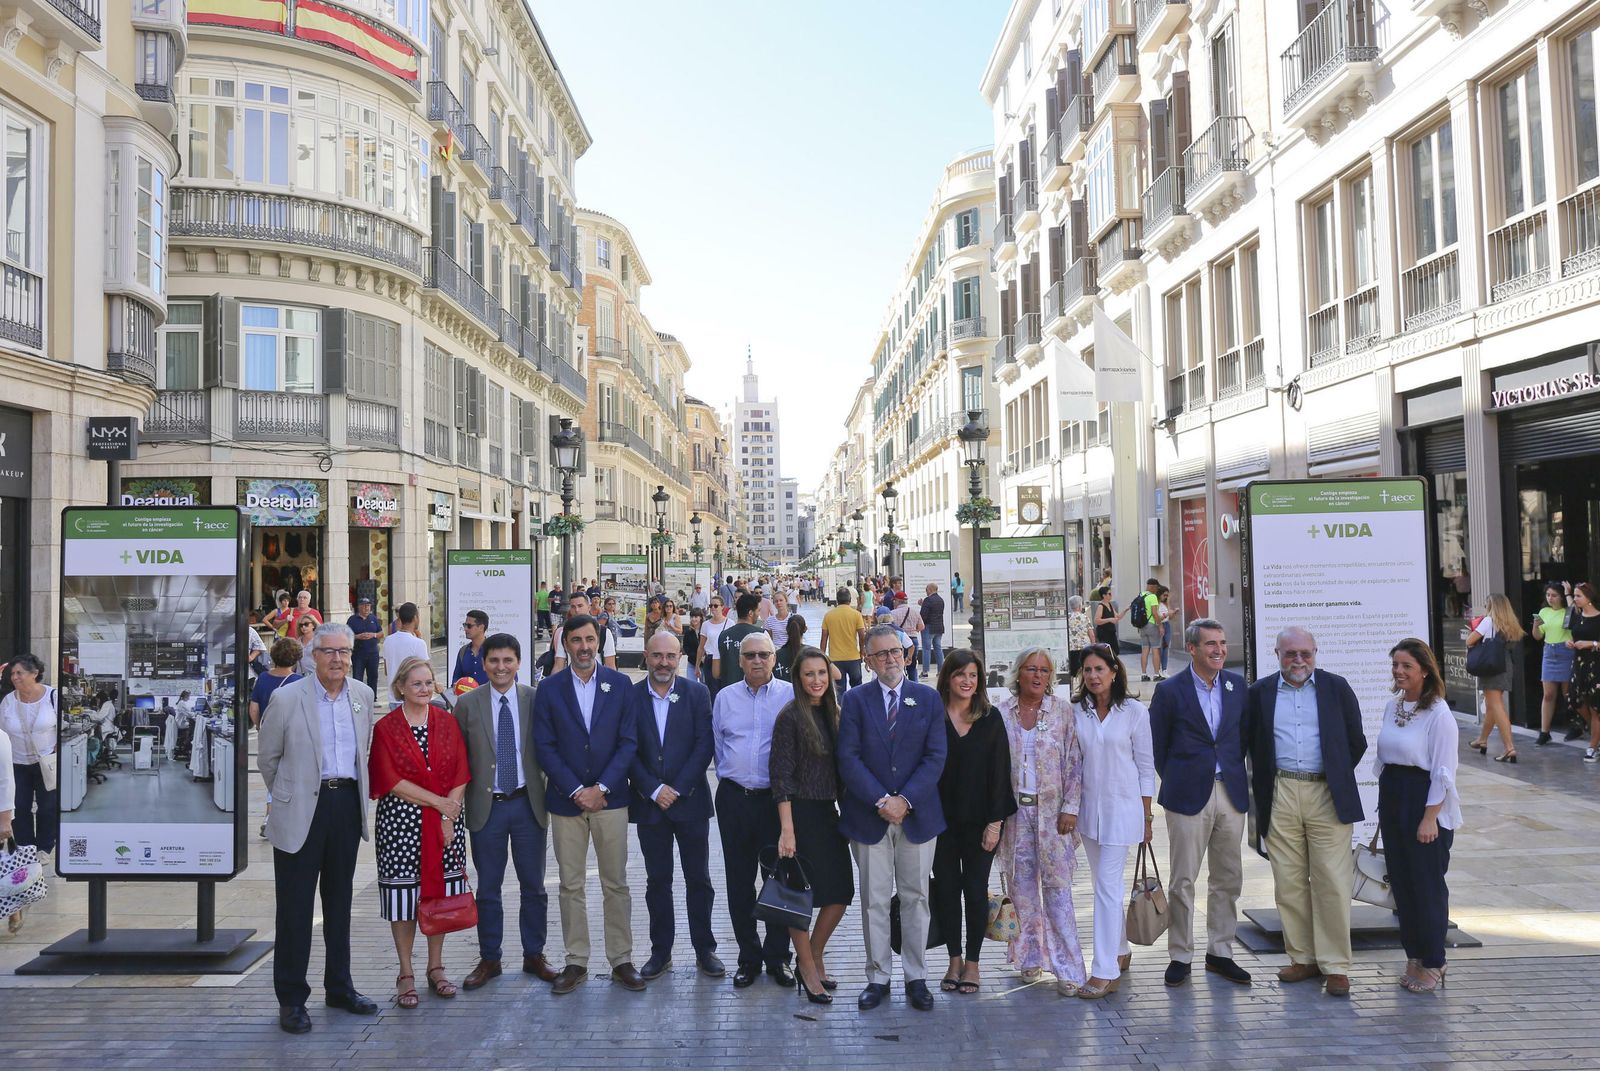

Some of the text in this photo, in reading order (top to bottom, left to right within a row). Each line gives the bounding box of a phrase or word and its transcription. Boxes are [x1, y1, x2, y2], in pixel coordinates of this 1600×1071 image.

[1492, 372, 1600, 408] VICTORIA'S SEC
[92, 427, 127, 438] NYX
[0, 470, 24, 478] AKEUP
[246, 493, 317, 511] Desigual
[356, 495, 397, 513] Desigual
[1391, 494, 1416, 502] aecc
[204, 521, 229, 529] aecc
[1324, 523, 1373, 538] VIDA
[136, 550, 184, 564] VIDA
[1016, 556, 1039, 564] VIDA
[482, 569, 506, 577] VIDA
[1197, 575, 1209, 600] 5G
